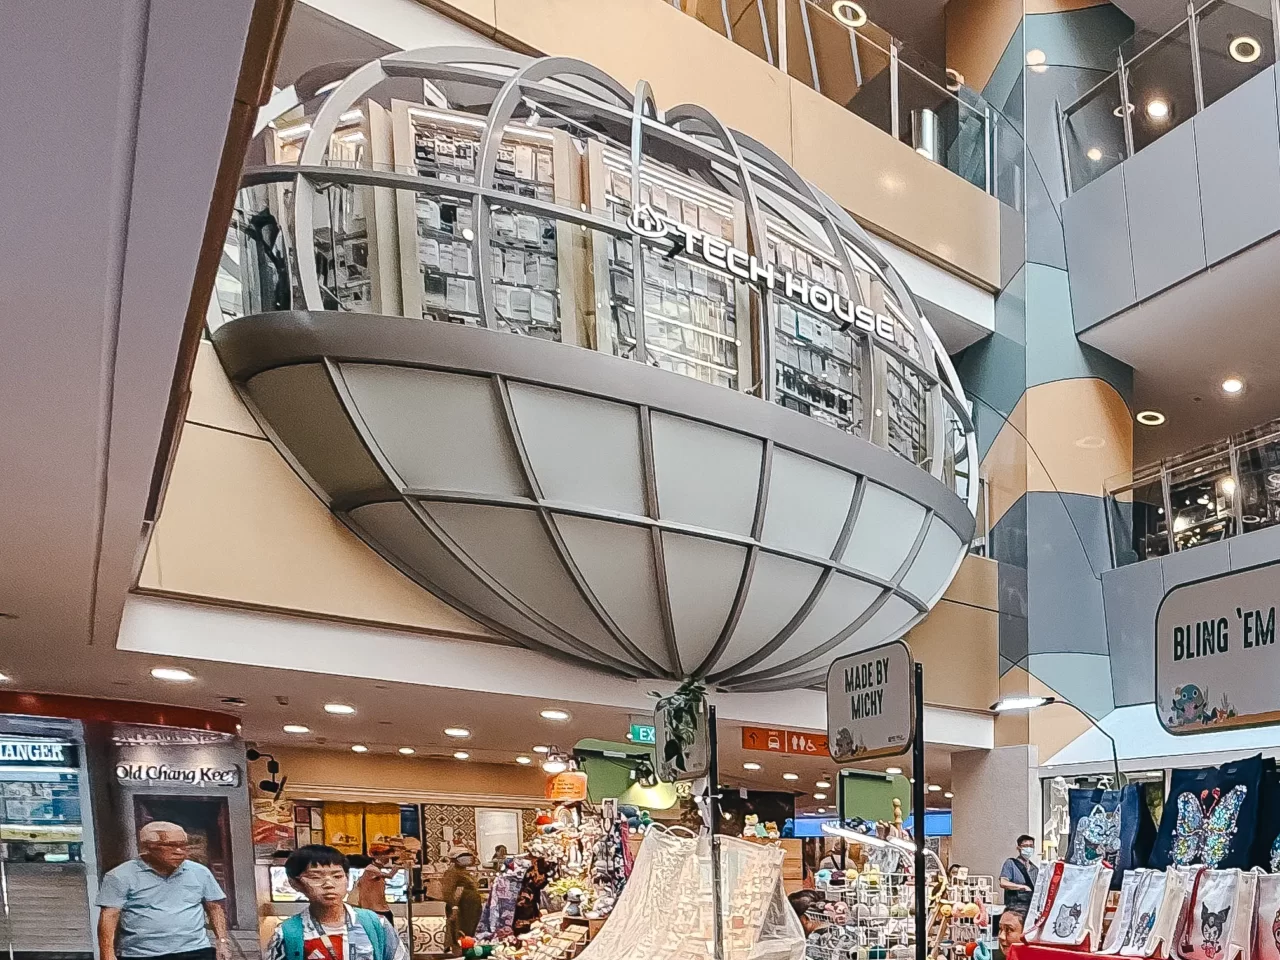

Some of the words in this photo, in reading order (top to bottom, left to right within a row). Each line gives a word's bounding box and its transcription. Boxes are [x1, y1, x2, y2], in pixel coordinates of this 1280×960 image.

[684, 230, 774, 290] TECH
[785, 272, 896, 342] HOUSE
[1173, 617, 1229, 662] BLING
[844, 661, 874, 694] MADE
[876, 656, 889, 686] BY
[851, 688, 884, 721] MICHY
[0, 744, 65, 761] ANGER
[116, 764, 142, 780] Old
[146, 764, 196, 784] Chang
[200, 767, 231, 781] Kee
